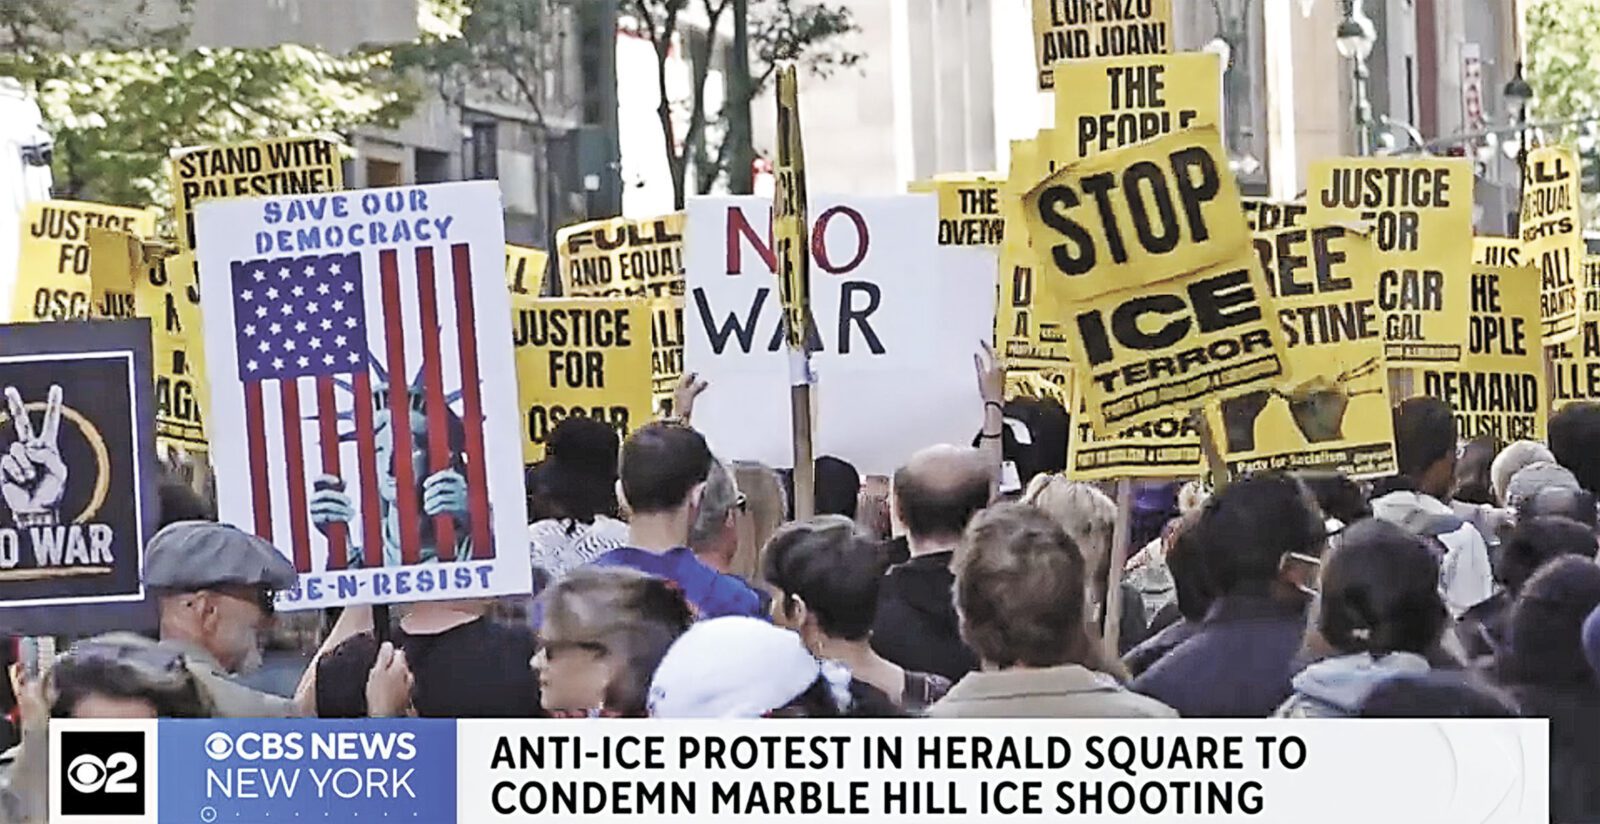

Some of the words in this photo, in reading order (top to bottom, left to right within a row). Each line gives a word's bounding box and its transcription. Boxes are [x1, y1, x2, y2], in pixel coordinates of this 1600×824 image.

[1043, 30, 1090, 65] AND
[1096, 22, 1167, 57] JOAN!
[1107, 64, 1165, 110] THE
[179, 146, 262, 179] STAND
[266, 138, 332, 169] WITH
[263, 195, 348, 224] SAVE
[361, 189, 428, 215] OUR
[957, 188, 999, 215] THE
[1321, 167, 1450, 208] JUSTICE
[1037, 146, 1220, 276] STOP
[255, 215, 453, 254] DEMOCRACY
[568, 220, 682, 254] FULL
[726, 205, 869, 275] NO
[58, 244, 91, 275] FO
[570, 256, 613, 287] AND
[619, 247, 685, 281] EQUAL
[1378, 269, 1444, 311] CAR
[1471, 273, 1502, 313] HE
[513, 308, 632, 347] JUSTICE
[1076, 269, 1262, 365] ICE
[1278, 299, 1379, 348] STINE
[1469, 315, 1527, 356] OPLE
[549, 350, 605, 388] FOR
[1094, 330, 1272, 392] TERROR
[1424, 369, 1538, 413] DEMAND
[30, 524, 114, 567] WAR
